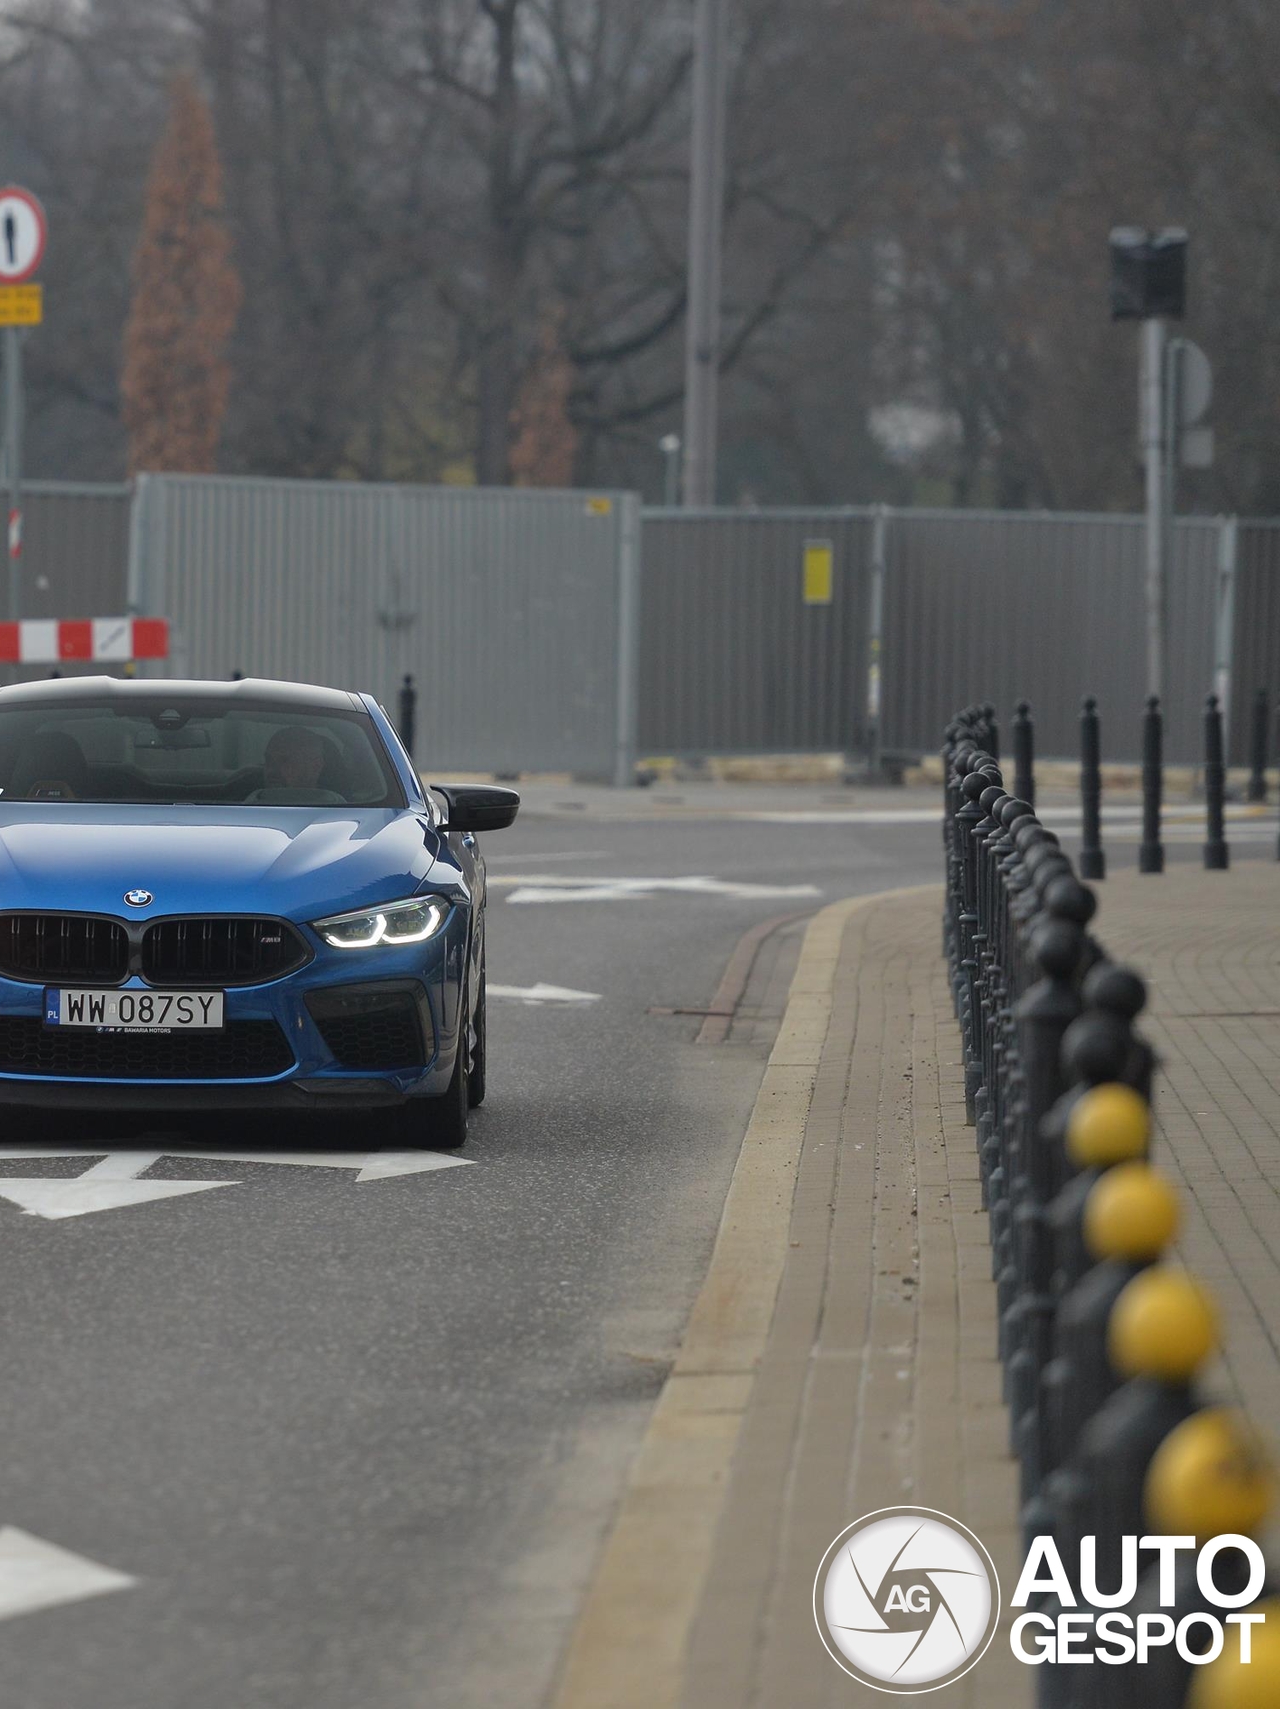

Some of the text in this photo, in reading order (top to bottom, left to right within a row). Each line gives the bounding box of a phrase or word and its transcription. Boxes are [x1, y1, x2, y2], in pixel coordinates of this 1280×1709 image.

[47, 1010, 58, 1019] PL
[67, 994, 215, 1025] WW 087SY
